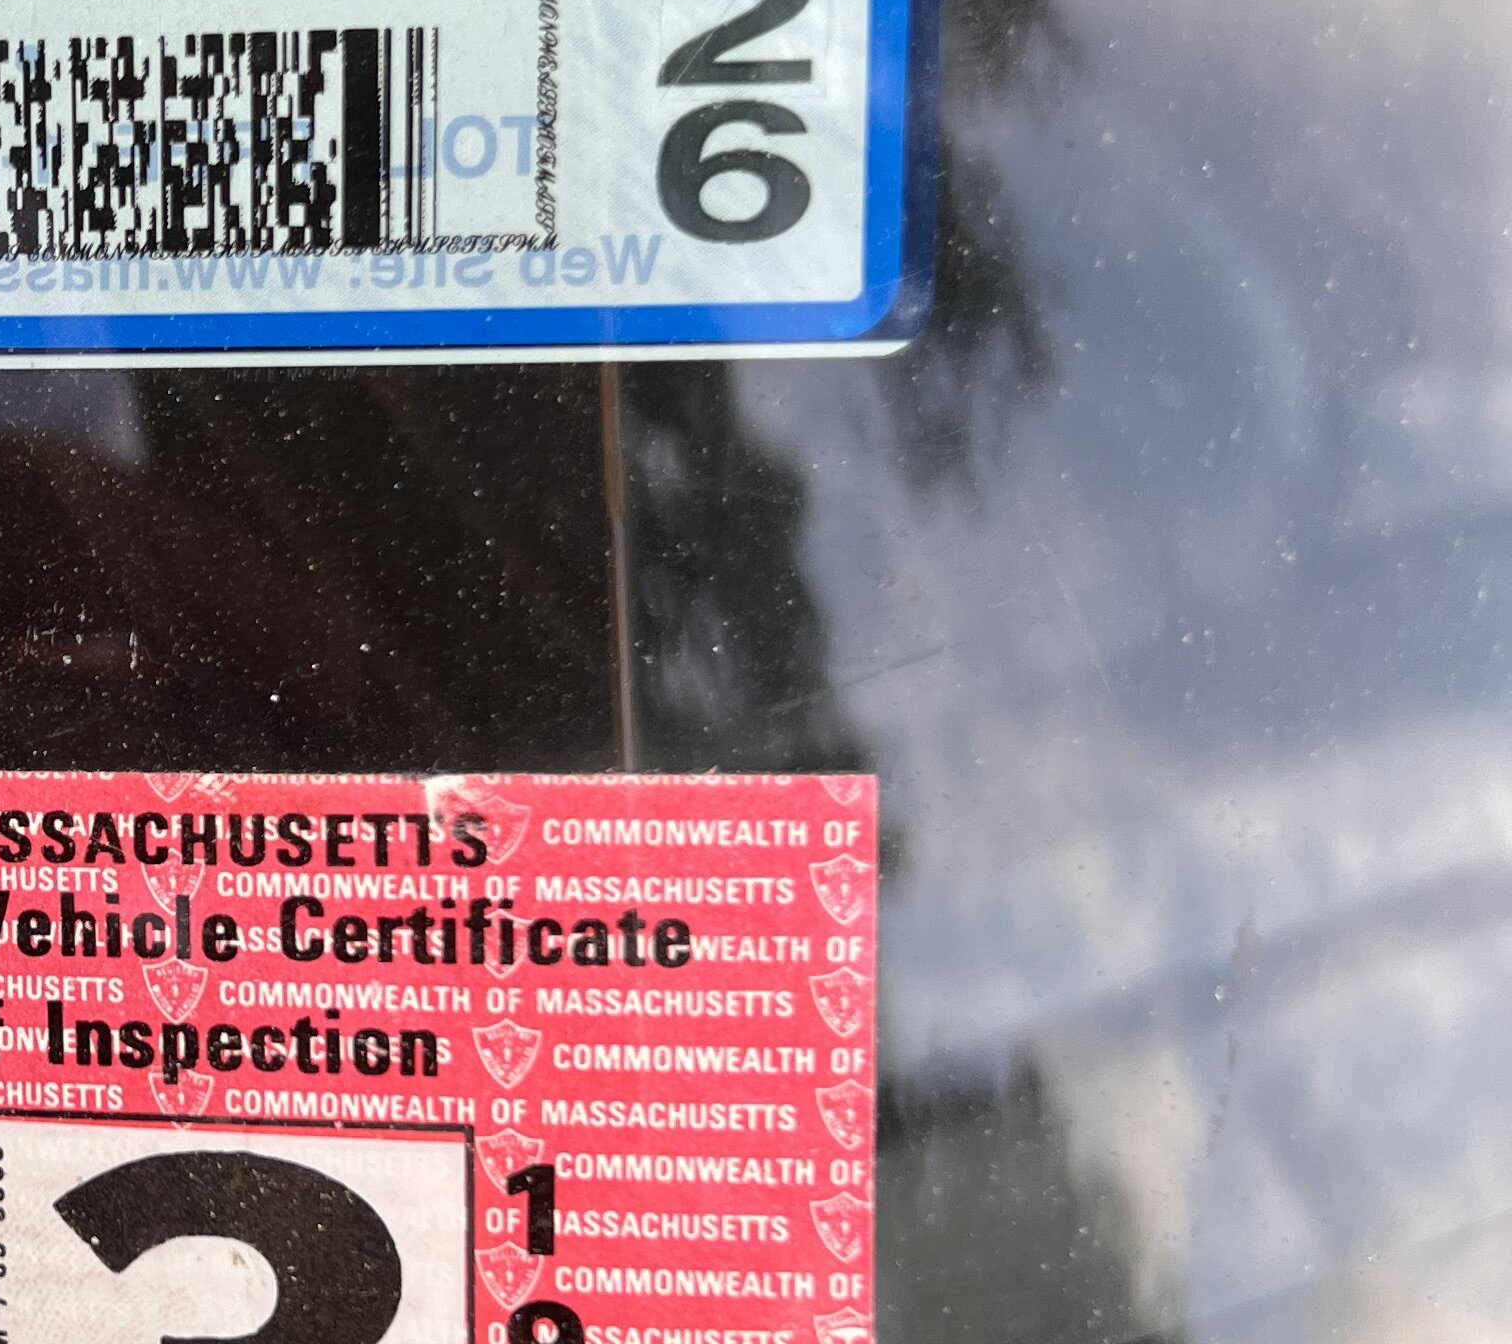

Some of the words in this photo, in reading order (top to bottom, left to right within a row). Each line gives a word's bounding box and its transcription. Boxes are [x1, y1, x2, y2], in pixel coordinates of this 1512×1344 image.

[542, 818, 808, 846] COMMONWEALTH
[823, 821, 861, 847] OF
[217, 871, 468, 901] COMMONWEALTH
[485, 876, 520, 901] OF
[536, 877, 794, 905] MASSACHUSETTS
[280, 895, 692, 968] Certificate
[827, 937, 863, 962] OF
[219, 980, 471, 1014] COMMONWEALTH
[486, 988, 521, 1014] OF
[537, 988, 793, 1018] MASSACHUSETTS
[47, 1000, 439, 1085] Inspection
[553, 1043, 814, 1073] COMMONWEALTH
[831, 1048, 866, 1073] OF
[226, 1089, 475, 1122] COMMONWEALTH
[491, 1098, 526, 1125] OF
[541, 1100, 797, 1131] MASSACHUSETTS
[555, 1152, 813, 1185] COMMONWEALTH
[830, 1159, 865, 1186] OF
[485, 1208, 521, 1233] OF
[555, 1266, 813, 1299] COMMONWEALTH
[830, 1273, 863, 1301] OF
